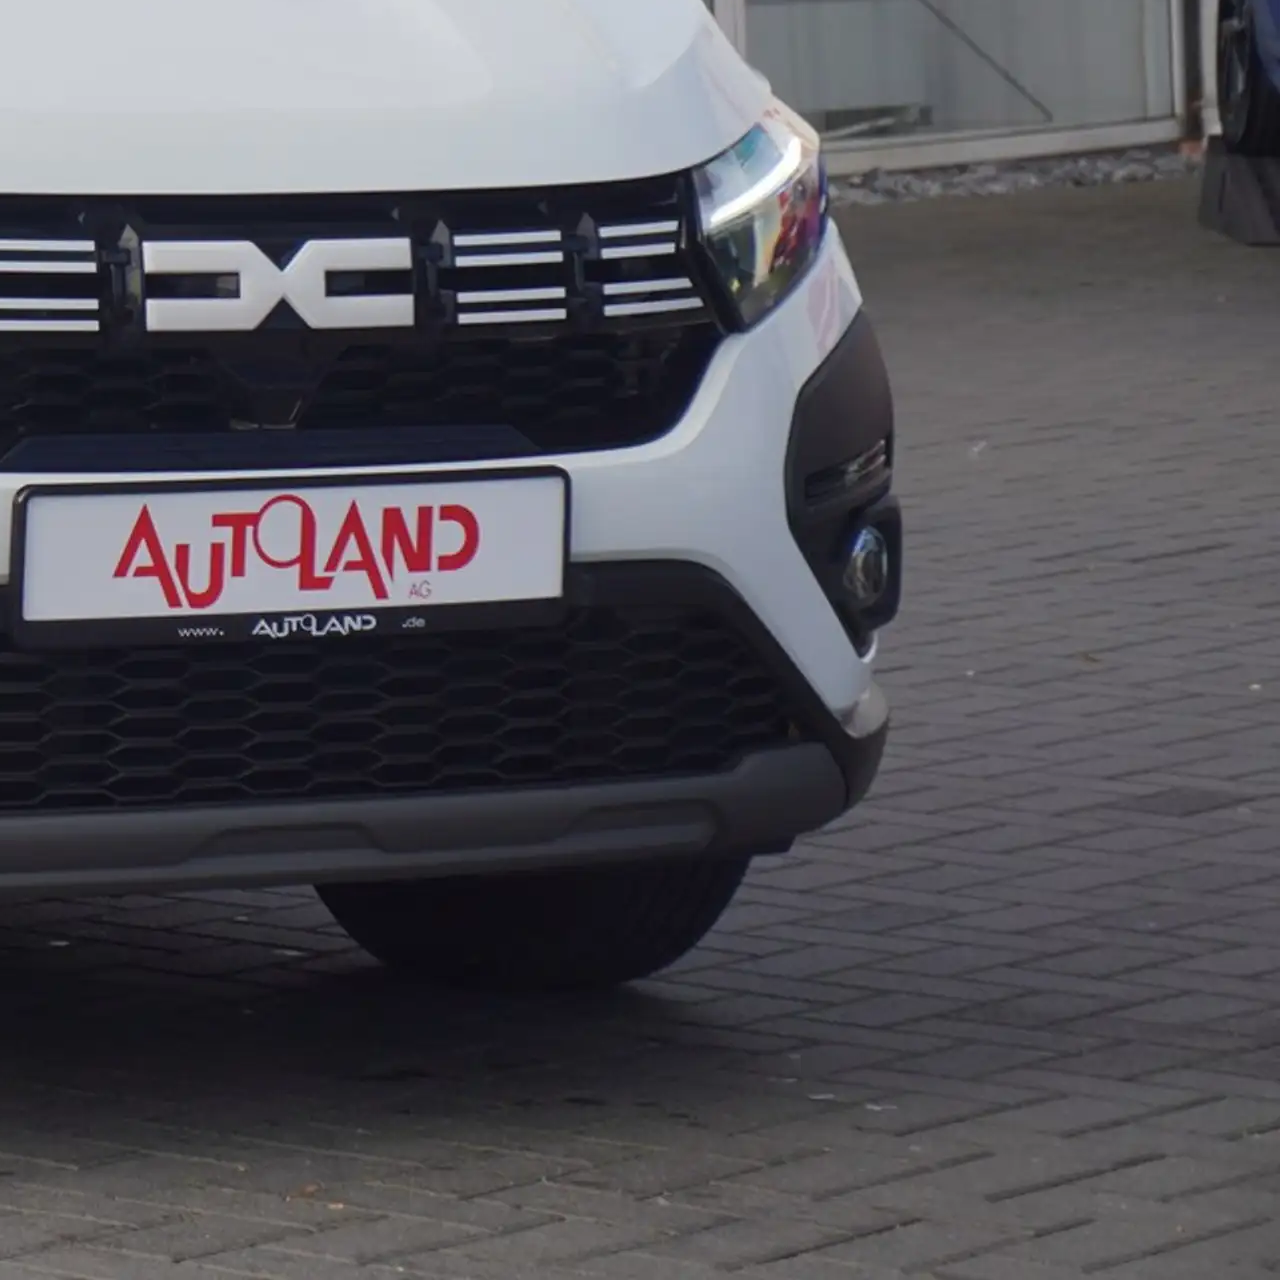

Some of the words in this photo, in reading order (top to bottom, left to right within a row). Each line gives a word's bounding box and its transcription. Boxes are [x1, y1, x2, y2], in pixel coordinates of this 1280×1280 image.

[112, 494, 480, 609] AUTOLAND
[408, 579, 433, 600] AG
[251, 613, 377, 639] AUTOLAND
